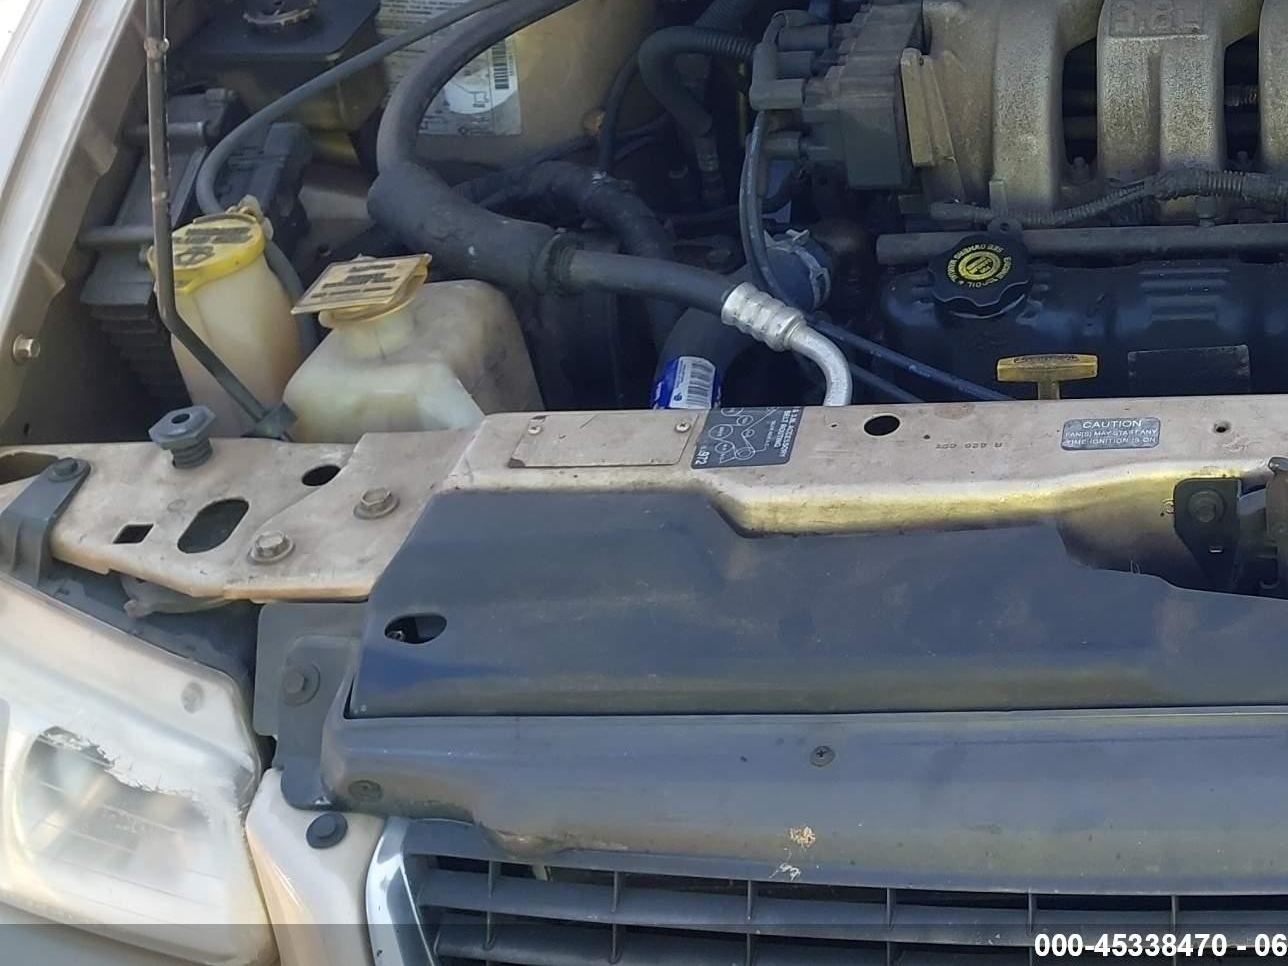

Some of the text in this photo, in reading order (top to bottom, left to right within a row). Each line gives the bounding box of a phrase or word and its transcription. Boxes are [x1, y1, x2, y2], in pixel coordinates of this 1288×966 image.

[774, 410, 791, 448] BELT ROUTING
[1082, 420, 1142, 429] CAUTION
[779, 425, 794, 457] ACCESSORY
